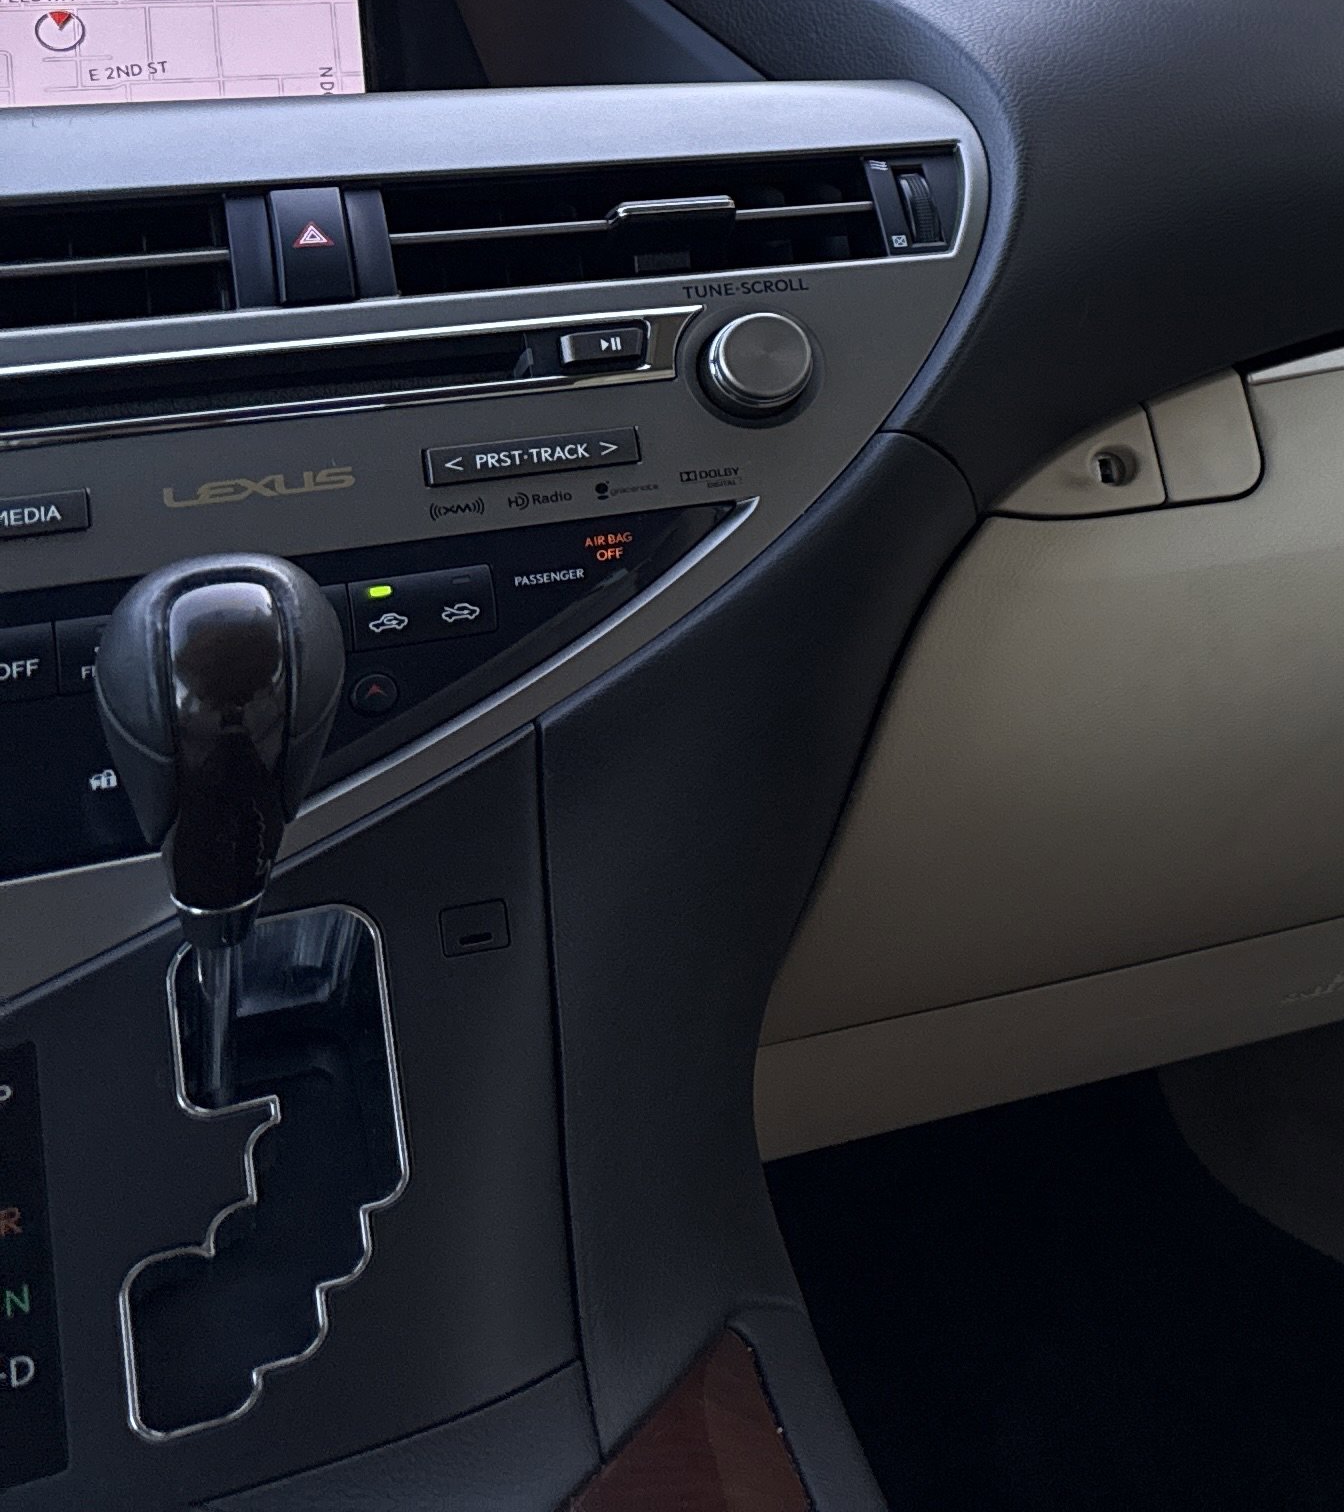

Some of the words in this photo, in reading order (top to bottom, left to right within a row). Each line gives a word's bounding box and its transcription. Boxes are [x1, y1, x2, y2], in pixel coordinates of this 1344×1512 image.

[89, 67, 100, 82] E
[105, 63, 143, 80] 2ND
[147, 60, 168, 75] ST
[699, 467, 740, 479] DOLBY
[162, 466, 356, 508] LEXUS
[533, 490, 573, 506] Radio
[585, 535, 606, 547] AIR
[608, 532, 633, 545] BAG
[596, 547, 624, 561] OFF
[514, 568, 585, 587] PASSENGER
[5, 1285, 30, 1317] N
